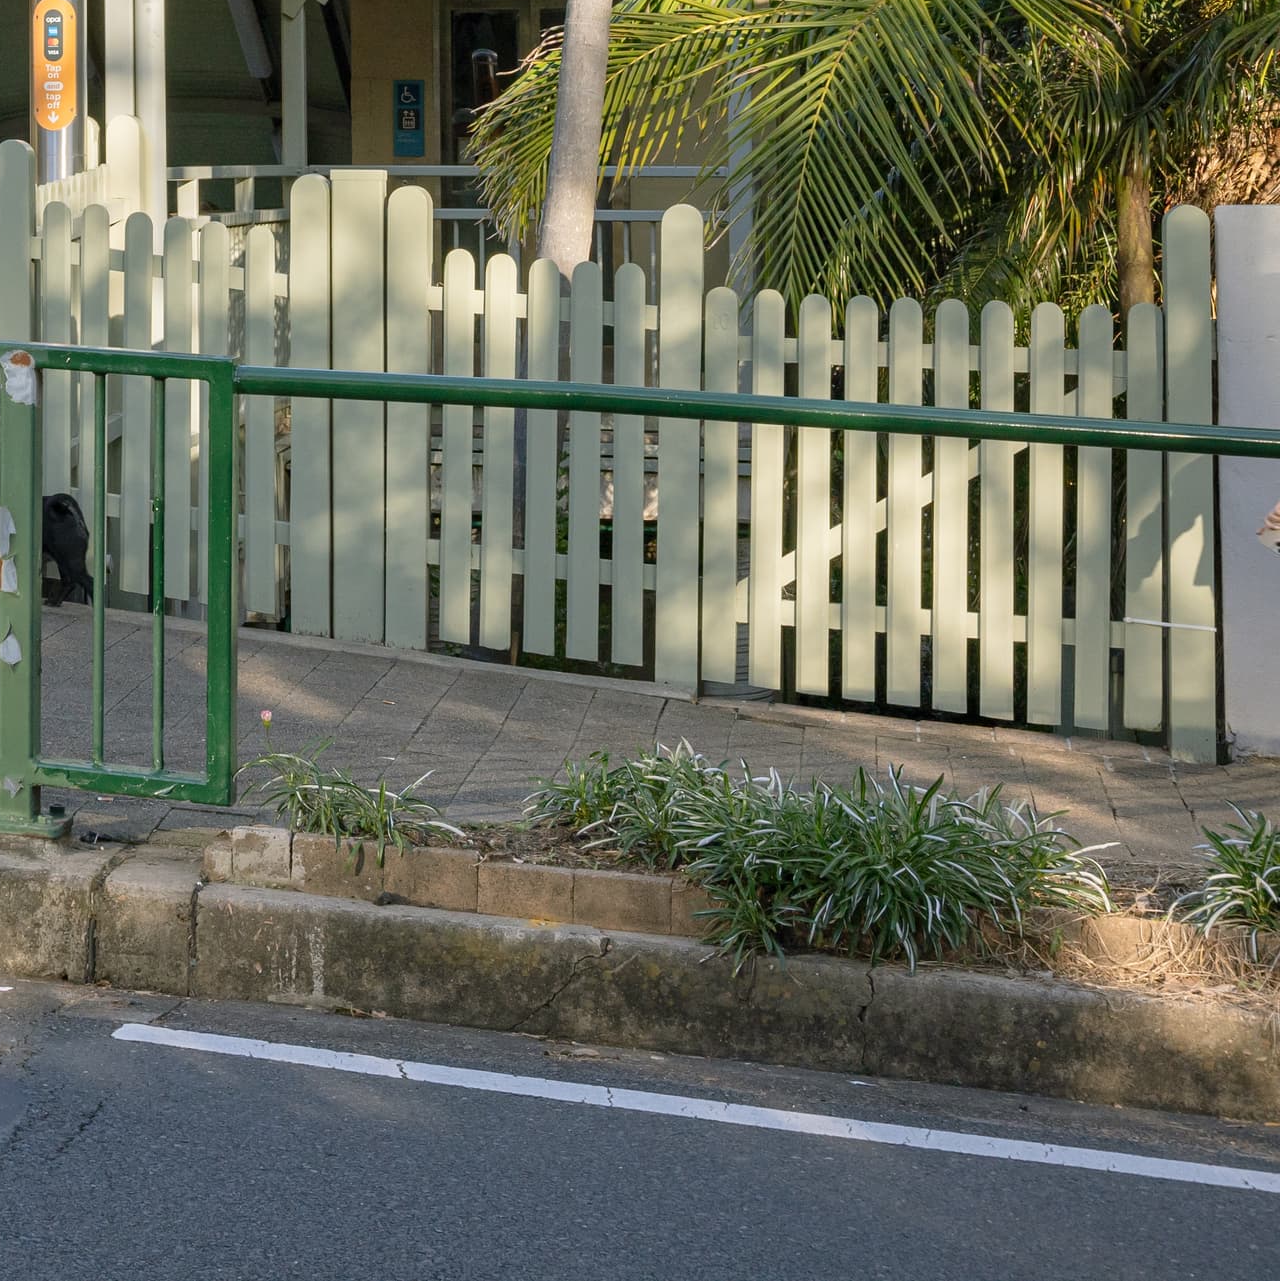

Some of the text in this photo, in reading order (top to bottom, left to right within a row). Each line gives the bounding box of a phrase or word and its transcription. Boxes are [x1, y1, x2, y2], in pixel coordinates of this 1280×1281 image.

[45, 64, 61, 72] Tap
[46, 93, 61, 101] tap
[47, 101, 60, 109] off
